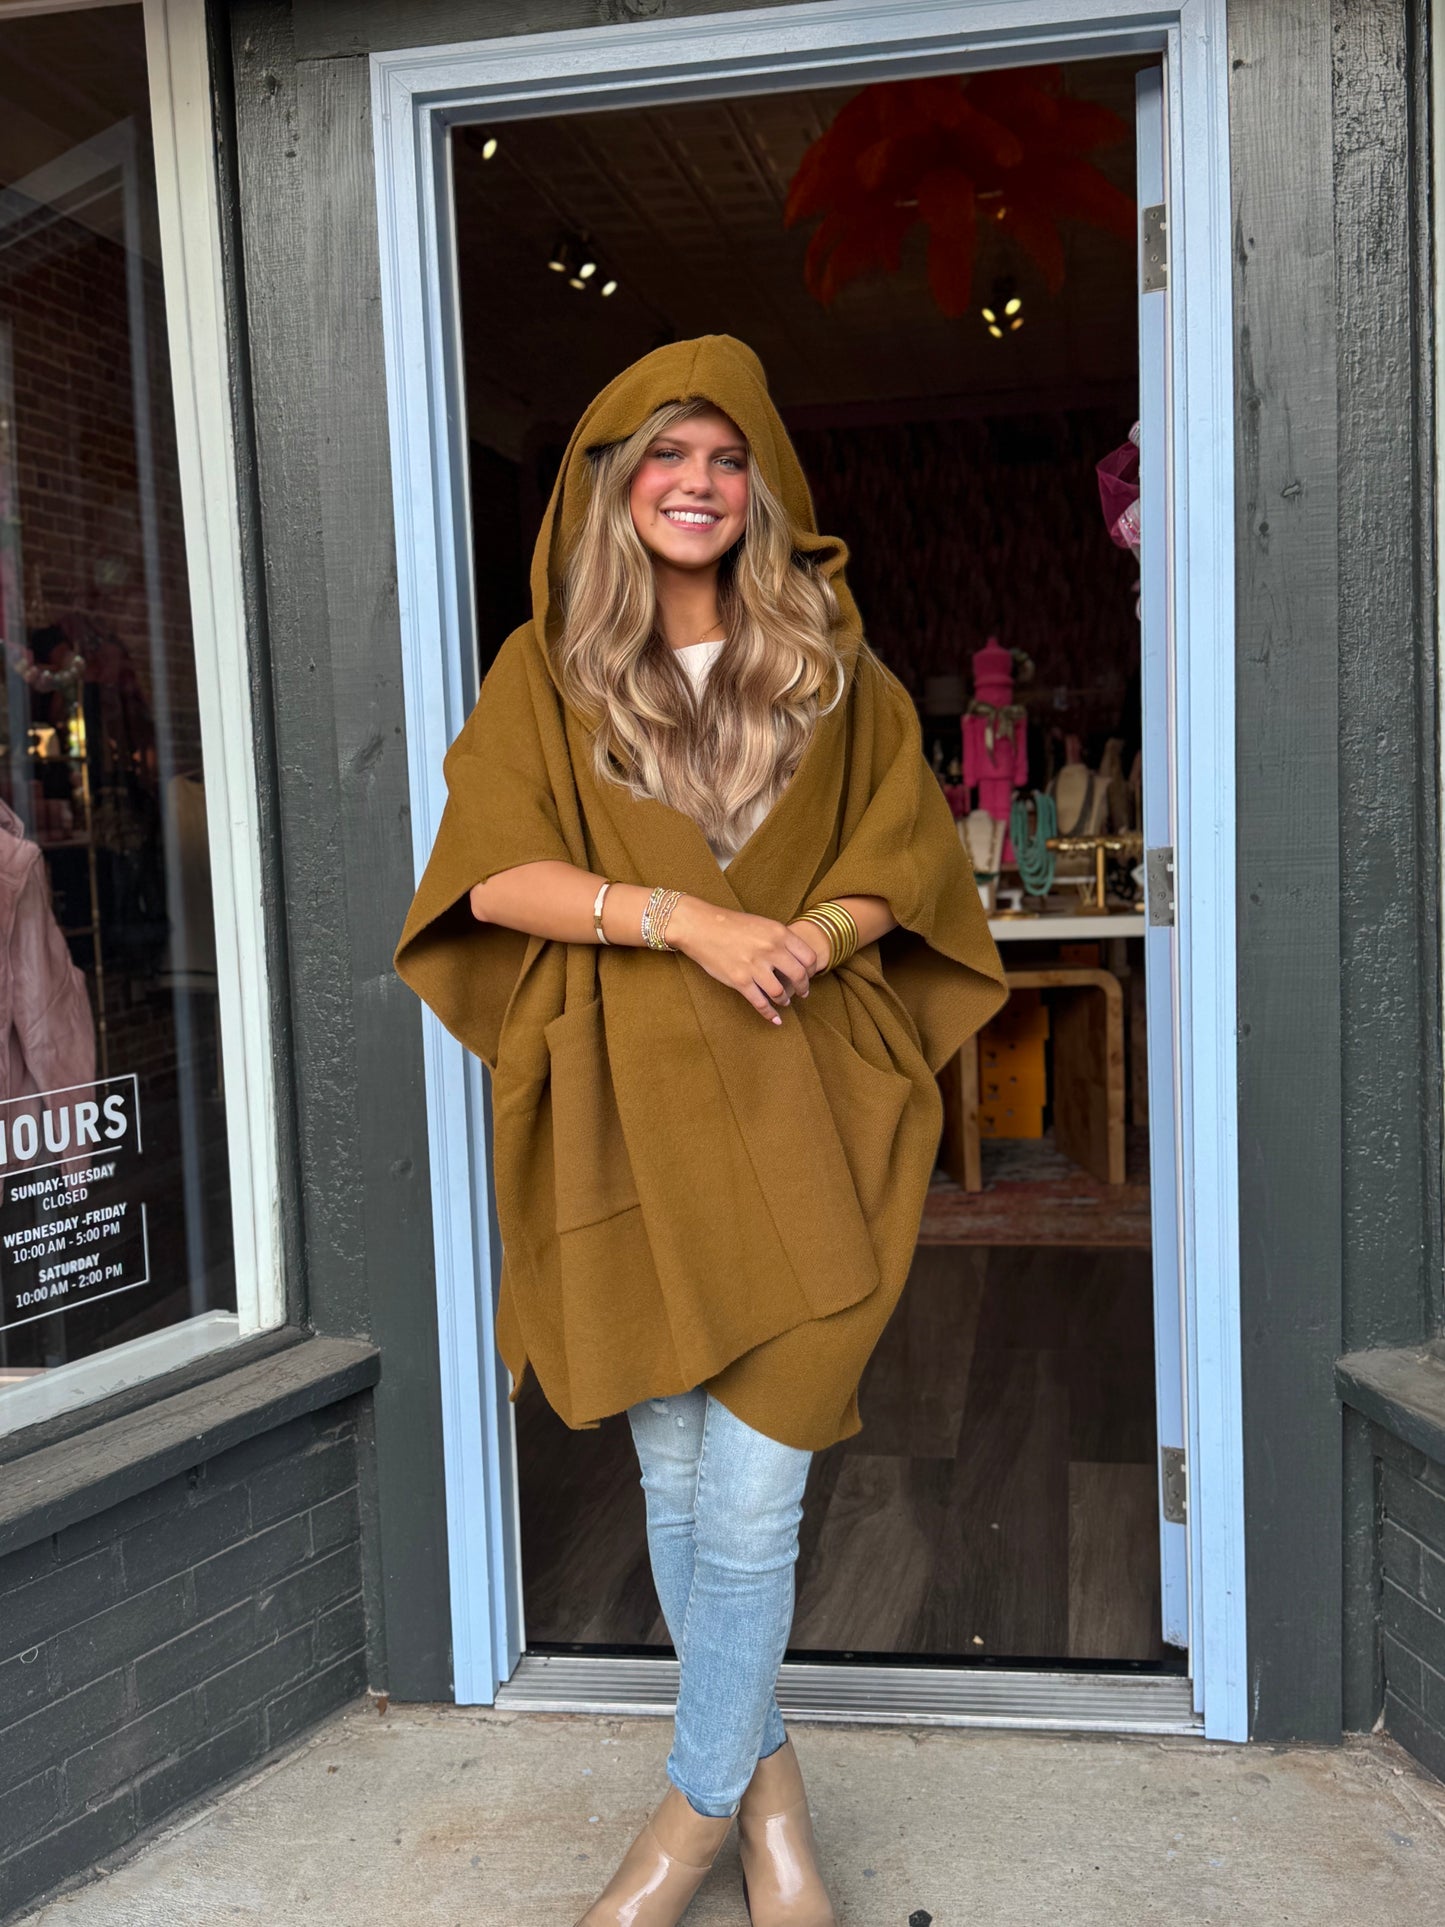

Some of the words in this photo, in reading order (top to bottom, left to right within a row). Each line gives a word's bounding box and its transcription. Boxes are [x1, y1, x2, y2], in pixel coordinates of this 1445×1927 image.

[11, 1162, 116, 1201] SUNDAY-TUESDAY
[42, 1188, 88, 1211] CLOSED
[3, 1216, 79, 1248] WEDNESDAY
[13, 1243, 46, 1264] 10:00
[47, 1237, 66, 1254] AM
[75, 1227, 100, 1246] 5:00
[102, 1221, 120, 1237] PM
[16, 1286, 48, 1308] 10:00
[50, 1280, 69, 1297] AM
[78, 1269, 103, 1288] 2:00
[105, 1262, 123, 1279] PM
[38, 1253, 100, 1283] SATURDAY
